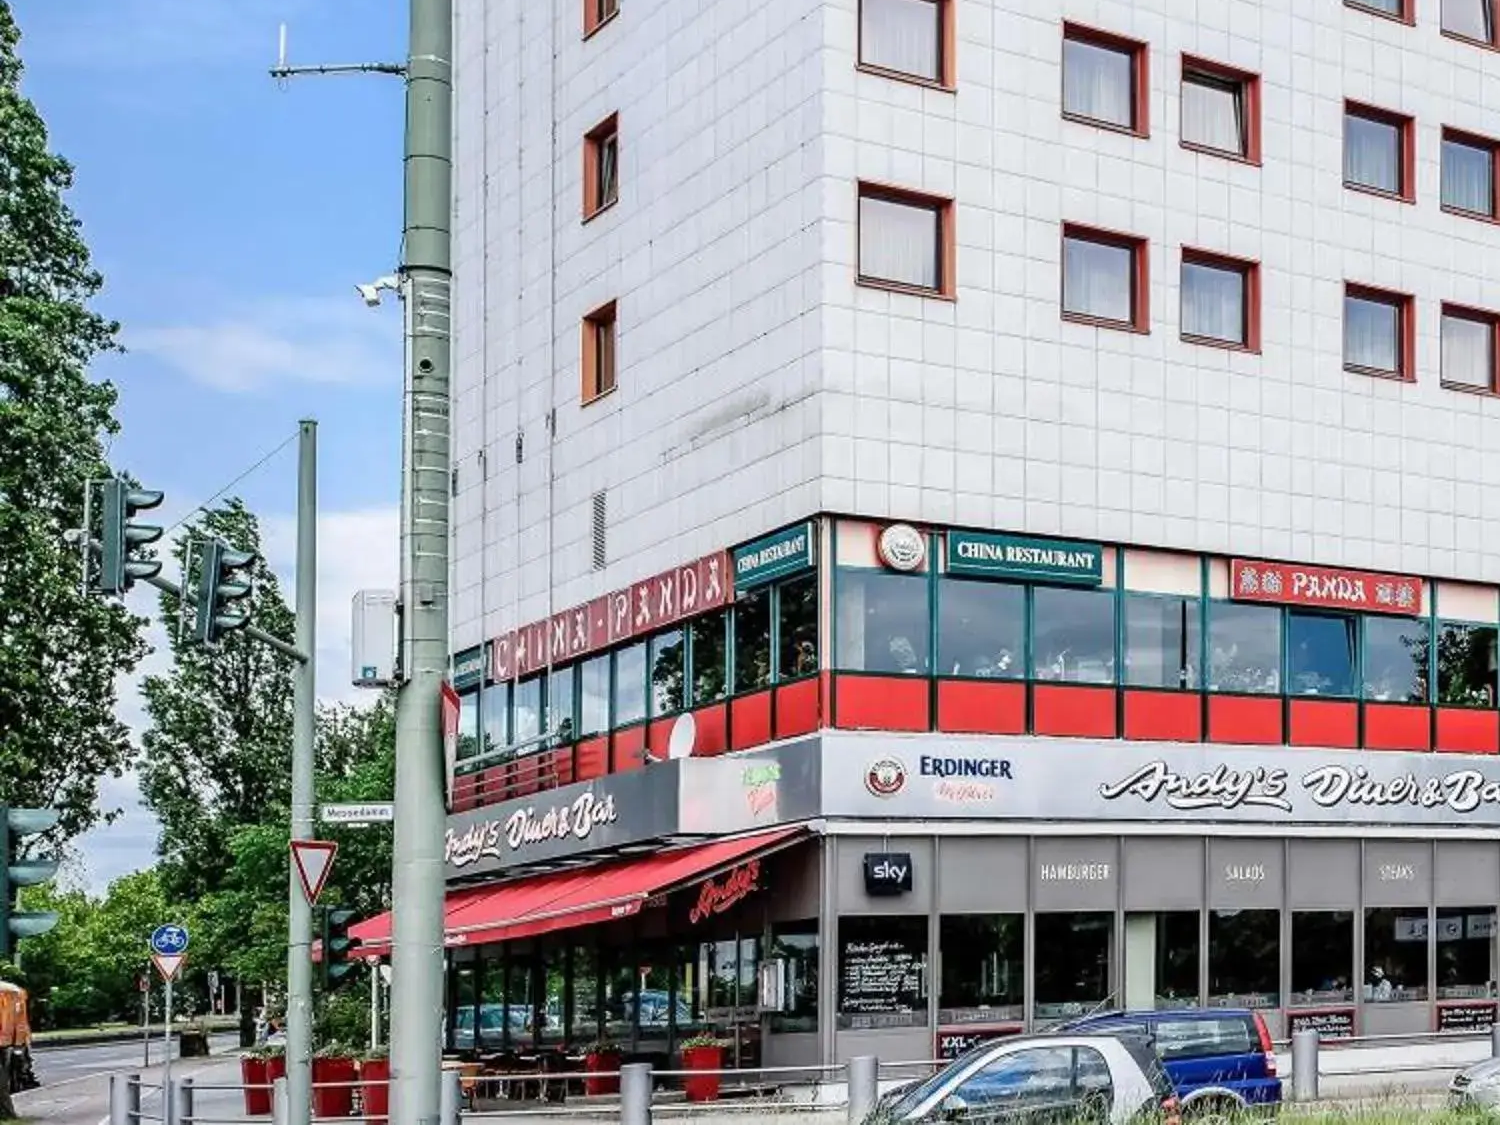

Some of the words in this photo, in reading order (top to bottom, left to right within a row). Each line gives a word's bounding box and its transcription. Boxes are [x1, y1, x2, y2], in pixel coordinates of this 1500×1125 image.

[957, 541, 1001, 560] CHINA
[1006, 547, 1094, 569] RESTAURANT
[1292, 572, 1367, 602] PANDA
[919, 755, 1013, 779] ERDINGER
[1100, 760, 1292, 812] Andy's
[873, 861, 907, 883] sky
[1041, 864, 1110, 880] HAMBURGER
[1225, 864, 1265, 880] SALADS
